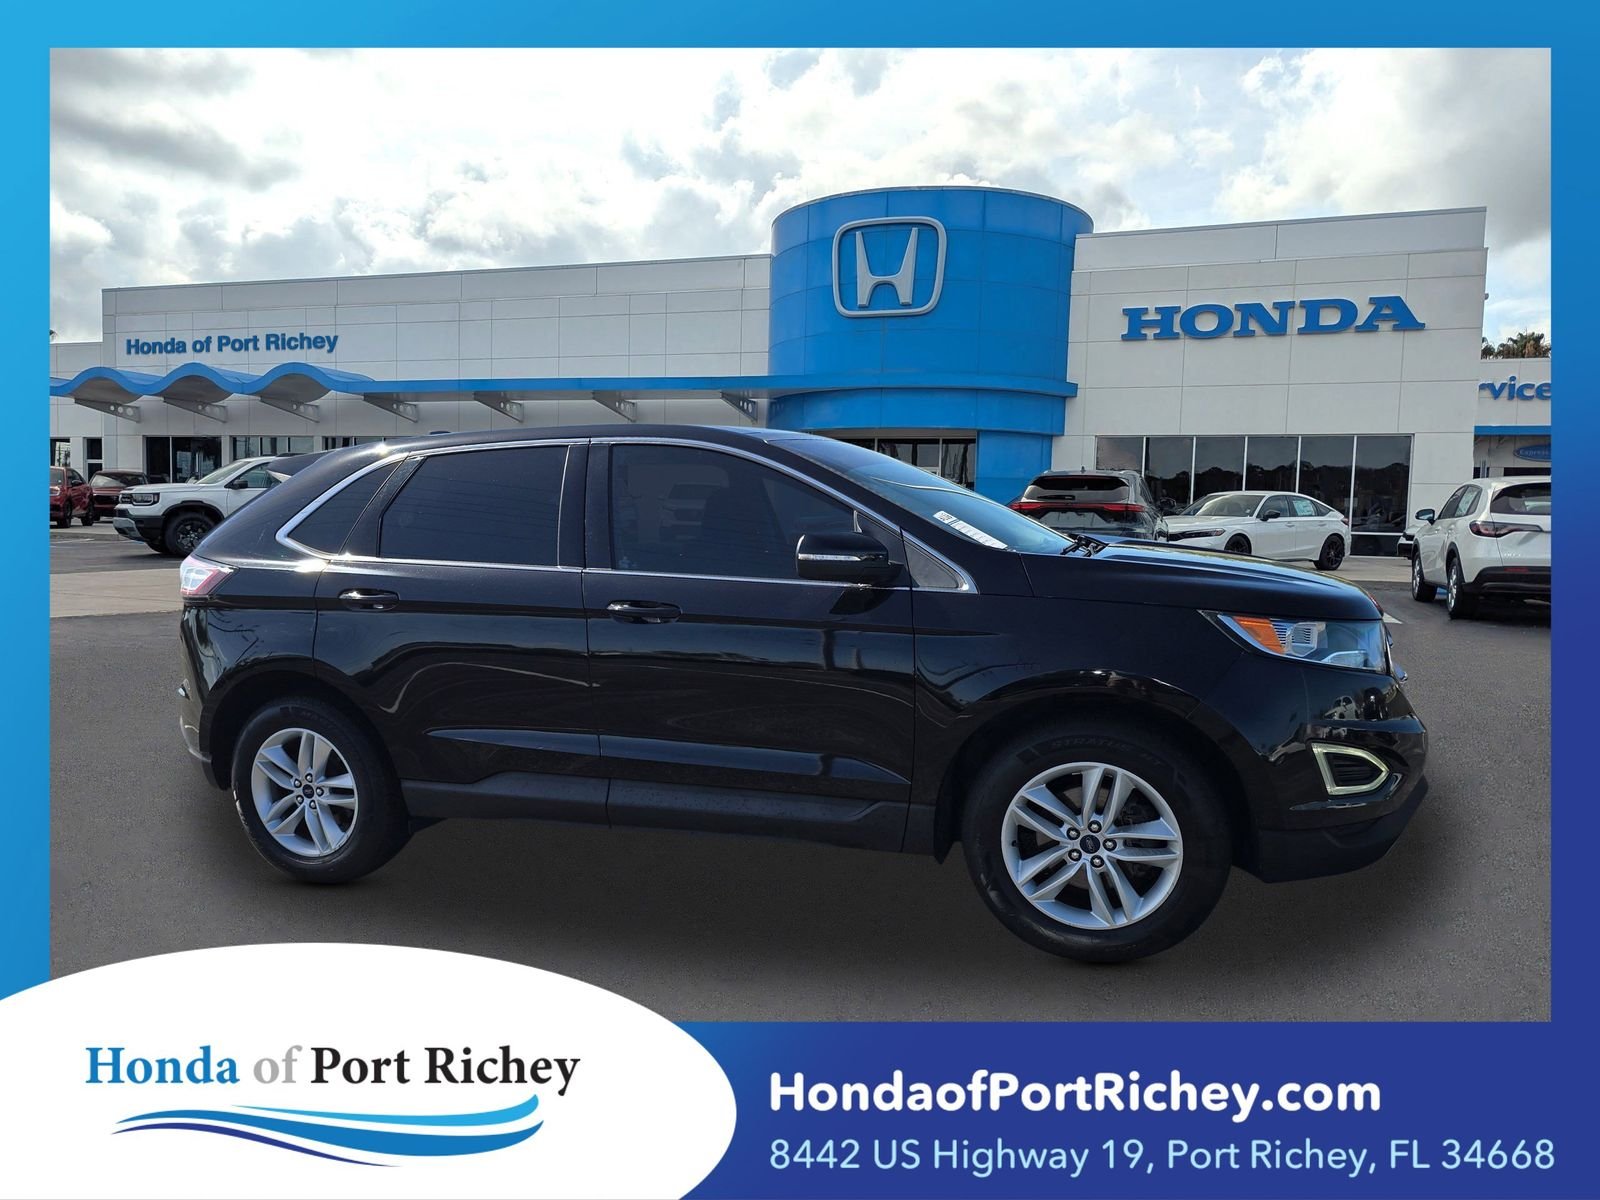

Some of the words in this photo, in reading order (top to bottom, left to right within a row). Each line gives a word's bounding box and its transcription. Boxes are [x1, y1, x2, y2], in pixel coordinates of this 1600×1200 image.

[1121, 295, 1425, 341] HONDA
[125, 337, 187, 355] Honda
[191, 335, 213, 353] of
[217, 334, 259, 353] Port
[265, 331, 339, 354] Richey
